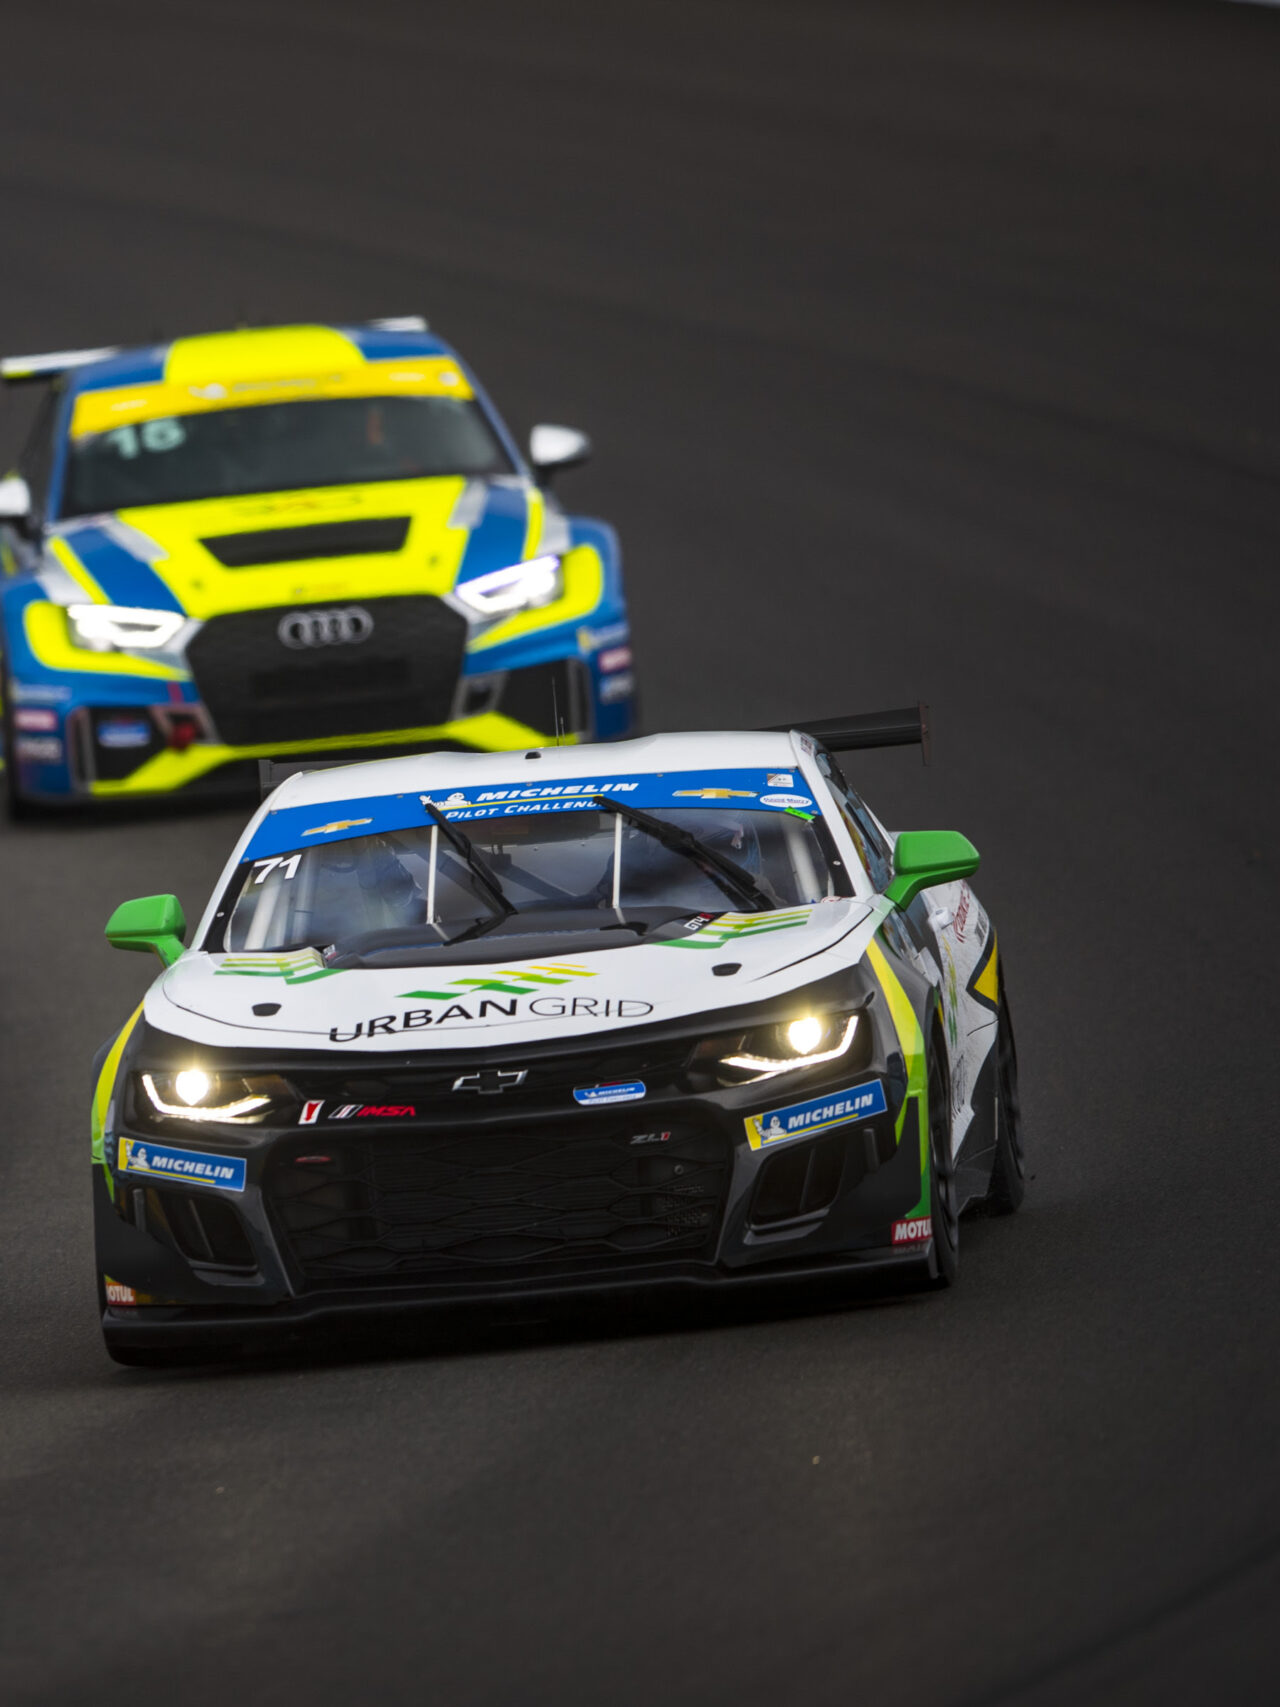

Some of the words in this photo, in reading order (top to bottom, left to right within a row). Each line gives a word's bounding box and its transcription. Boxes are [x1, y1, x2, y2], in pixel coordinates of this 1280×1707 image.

[476, 782, 639, 802] MICHELIN
[445, 807, 499, 820] PILOT
[504, 800, 604, 815] CHALLENG
[253, 854, 302, 885] 71
[356, 1105, 416, 1117] IMSA
[787, 1093, 874, 1130] MICHELIN
[151, 1155, 235, 1180] MICHELIN
[106, 1285, 134, 1302] OTUL
